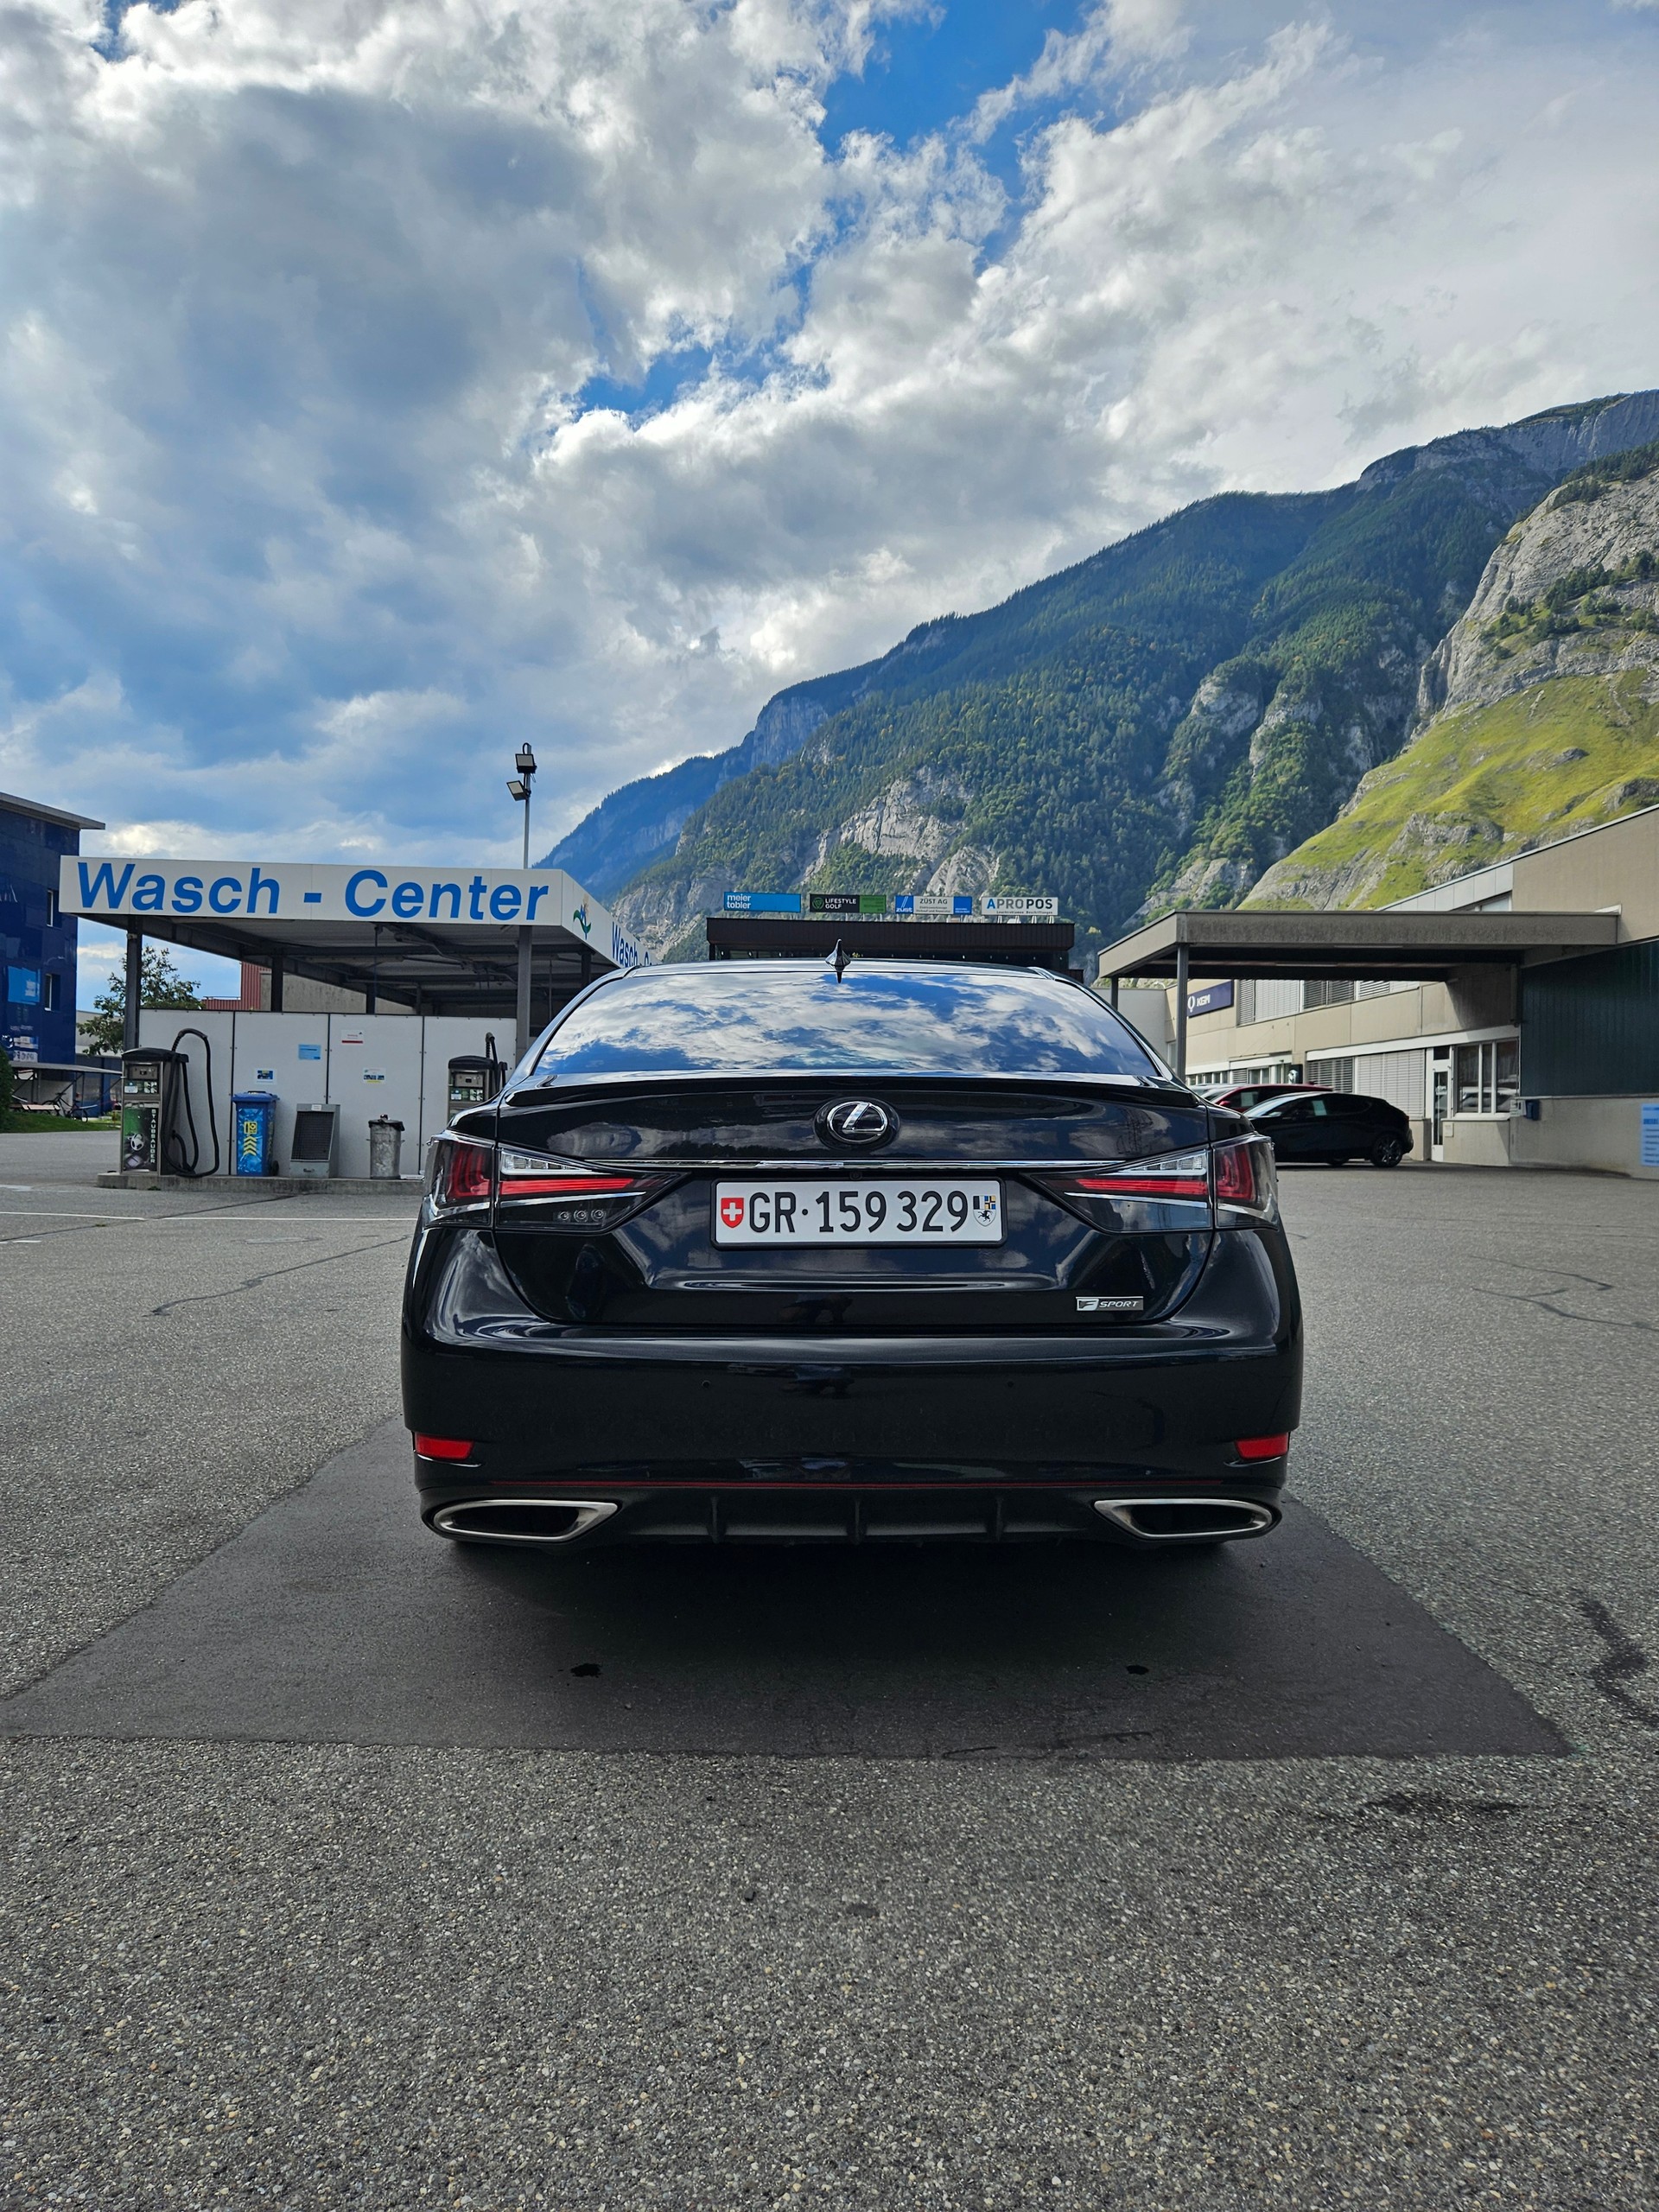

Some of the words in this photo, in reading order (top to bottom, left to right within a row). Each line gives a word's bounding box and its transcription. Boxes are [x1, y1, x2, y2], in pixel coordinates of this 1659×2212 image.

[77, 861, 280, 914] Wasch
[345, 869, 549, 921] Center
[727, 901, 752, 910] tobler
[612, 921, 639, 968] Wasch
